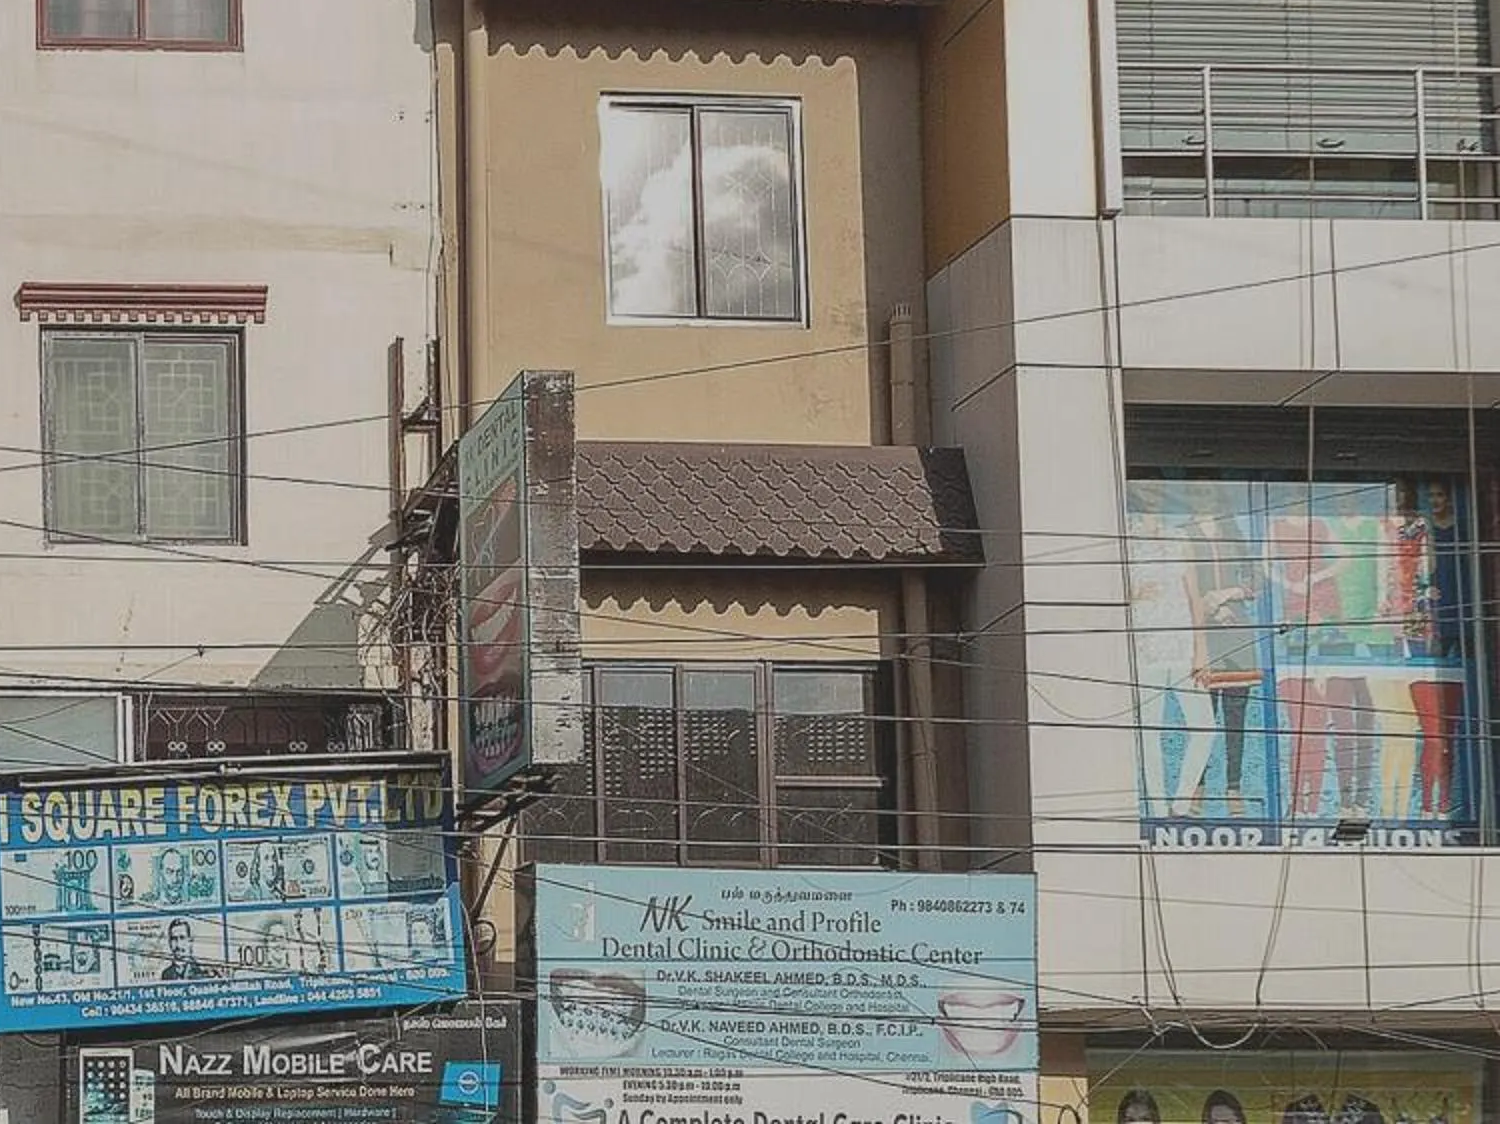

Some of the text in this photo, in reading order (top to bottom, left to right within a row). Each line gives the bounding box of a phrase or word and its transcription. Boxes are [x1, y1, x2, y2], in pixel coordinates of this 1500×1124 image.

[21, 785, 166, 844] SQUARE
[176, 781, 293, 837] FOREX
[1155, 826, 1263, 848] NOOR
[66, 849, 98, 871] 100
[192, 848, 216, 866] 100
[639, 895, 882, 933] NK Smile and Profile
[891, 899, 907, 912] Ph
[1009, 901, 1025, 914] 74
[238, 945, 265, 966] 100
[602, 936, 983, 965] Dental Clinic & Orthodontic Center
[705, 970, 770, 984] SHAKEEL
[709, 1020, 766, 1033] NAVEED
[193, 1086, 225, 1098] Brand
[227, 1086, 263, 1098] Mobile
[277, 1086, 315, 1100] Laptop
[316, 1085, 357, 1097] Service
[359, 1085, 389, 1097] Done
